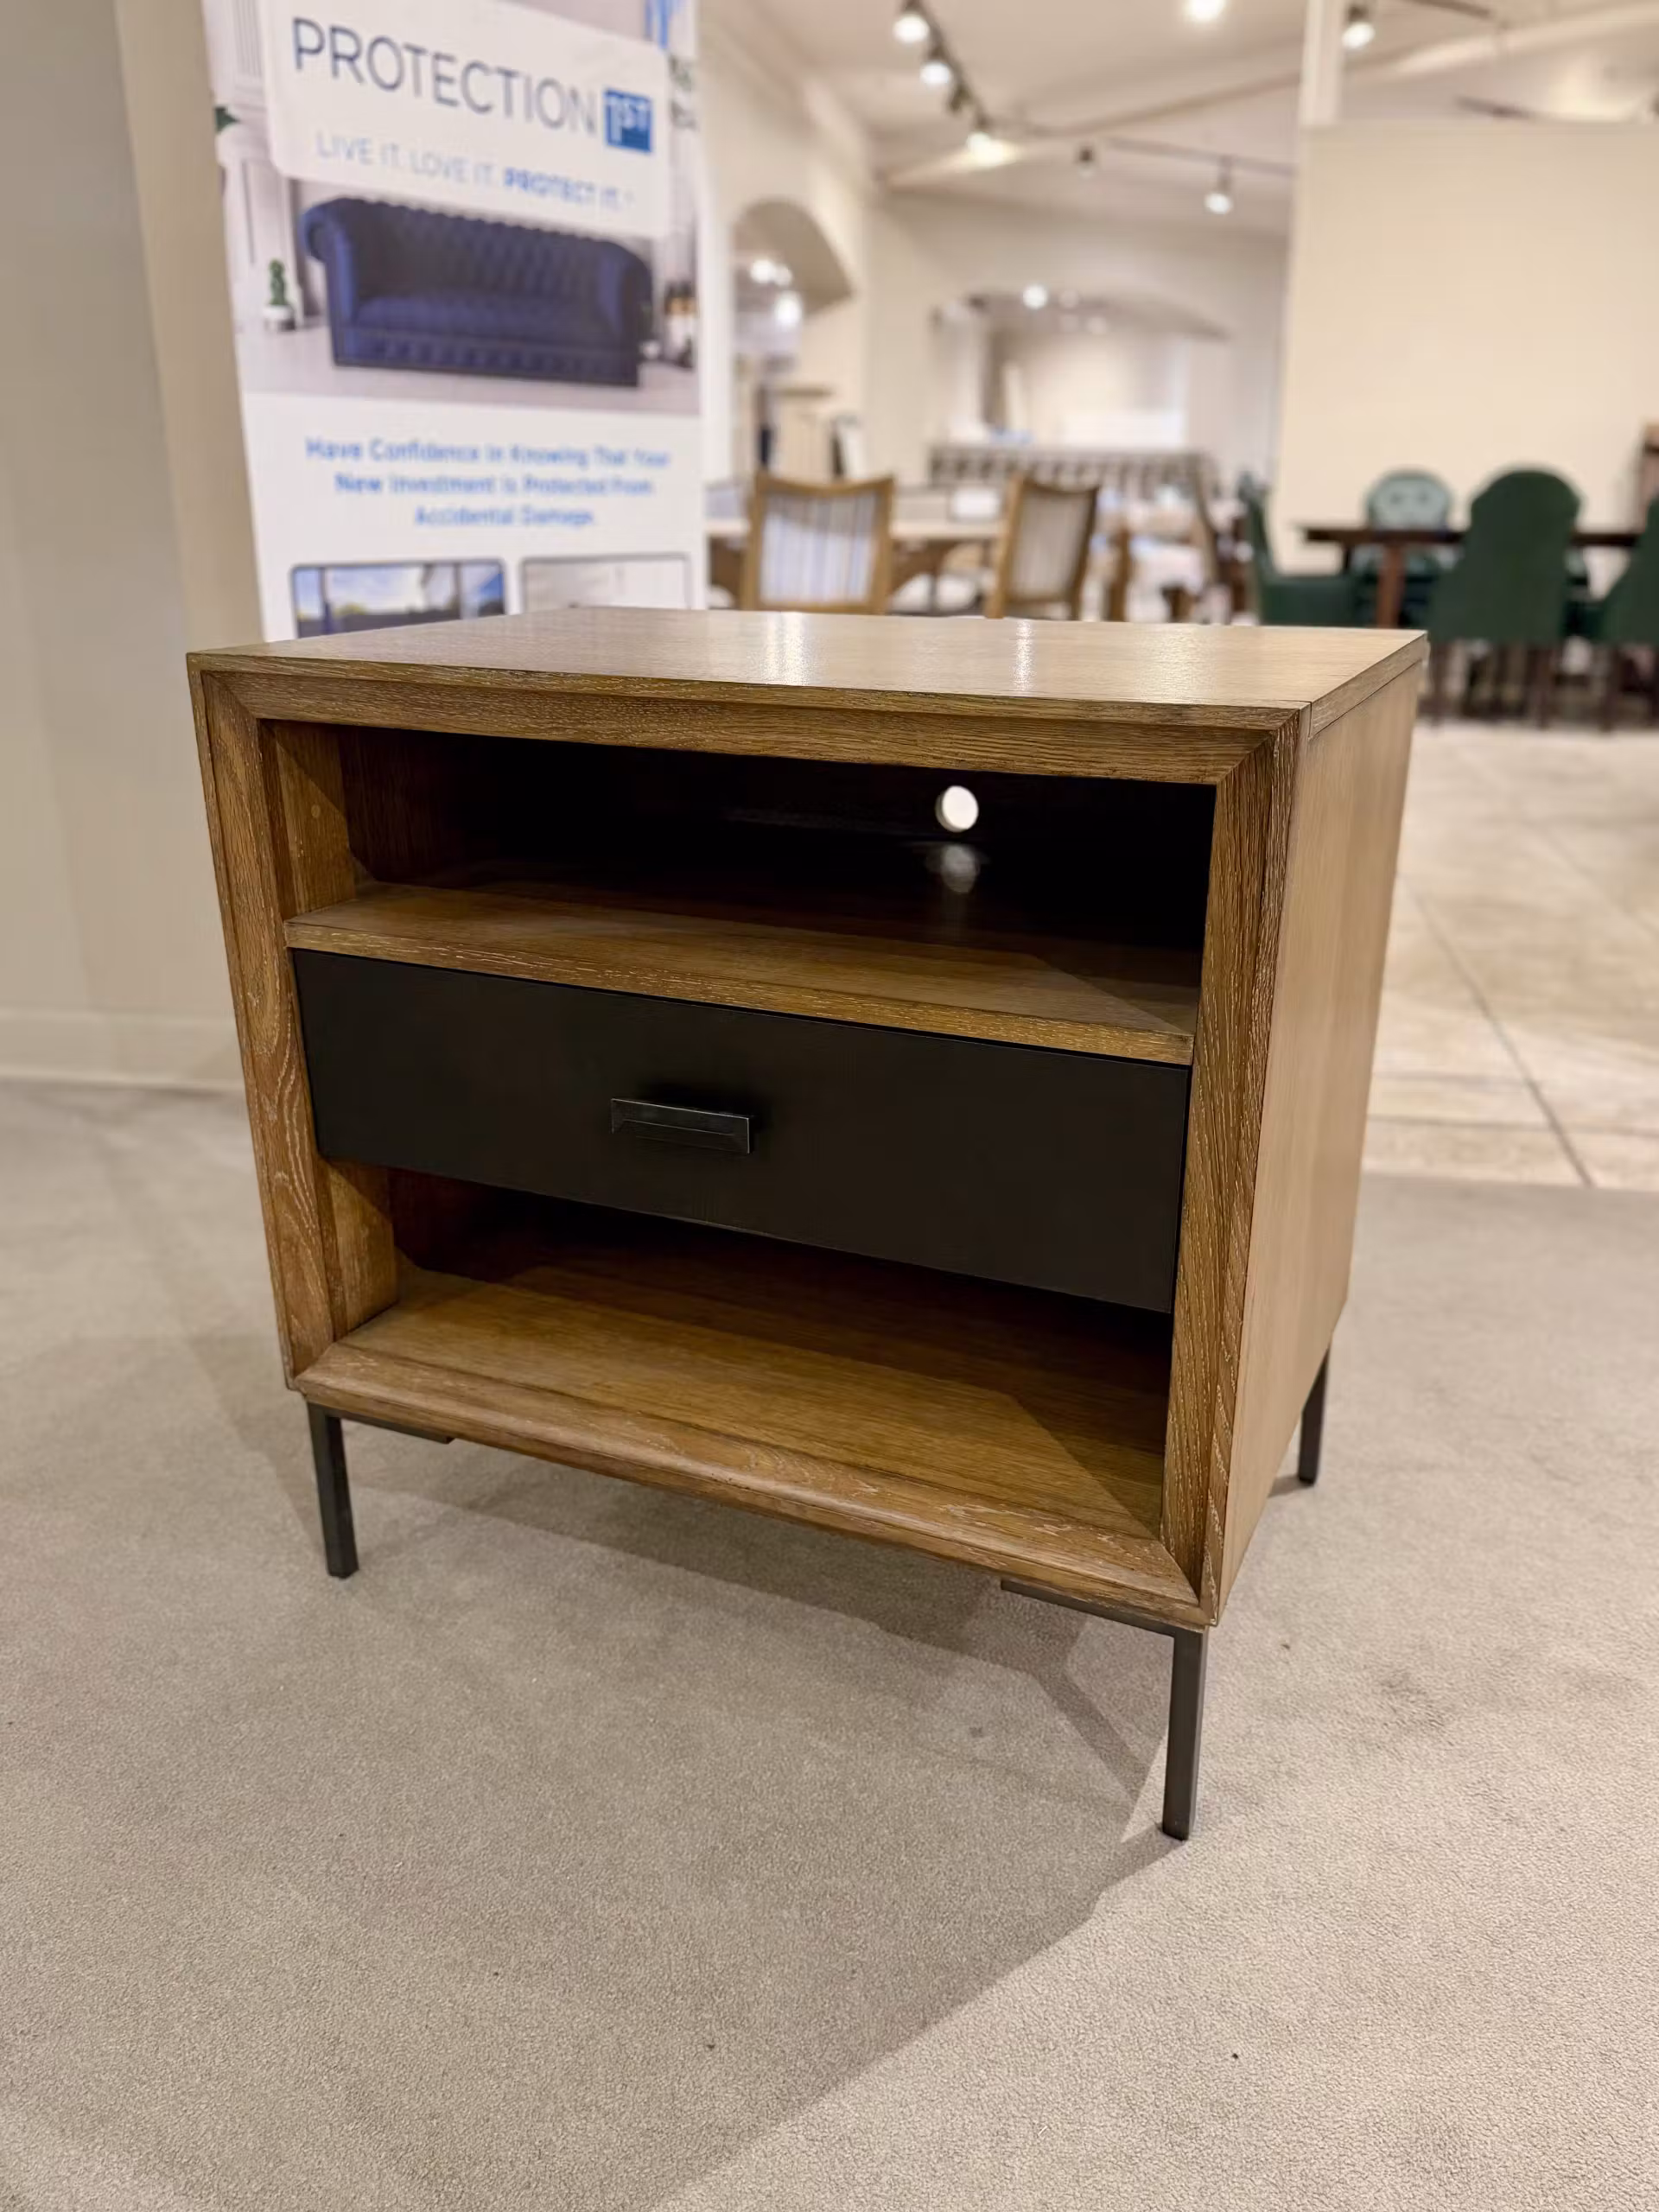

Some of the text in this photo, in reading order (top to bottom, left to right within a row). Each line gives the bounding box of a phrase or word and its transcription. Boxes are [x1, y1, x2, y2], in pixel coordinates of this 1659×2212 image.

[292, 16, 598, 137] PROTECTION
[315, 130, 373, 165] LIVE
[410, 149, 468, 184] LOVE
[504, 167, 594, 206] PROTECT
[306, 437, 361, 461] Have
[369, 438, 479, 462] Confidence
[334, 474, 383, 493] New
[391, 474, 493, 495] Investment
